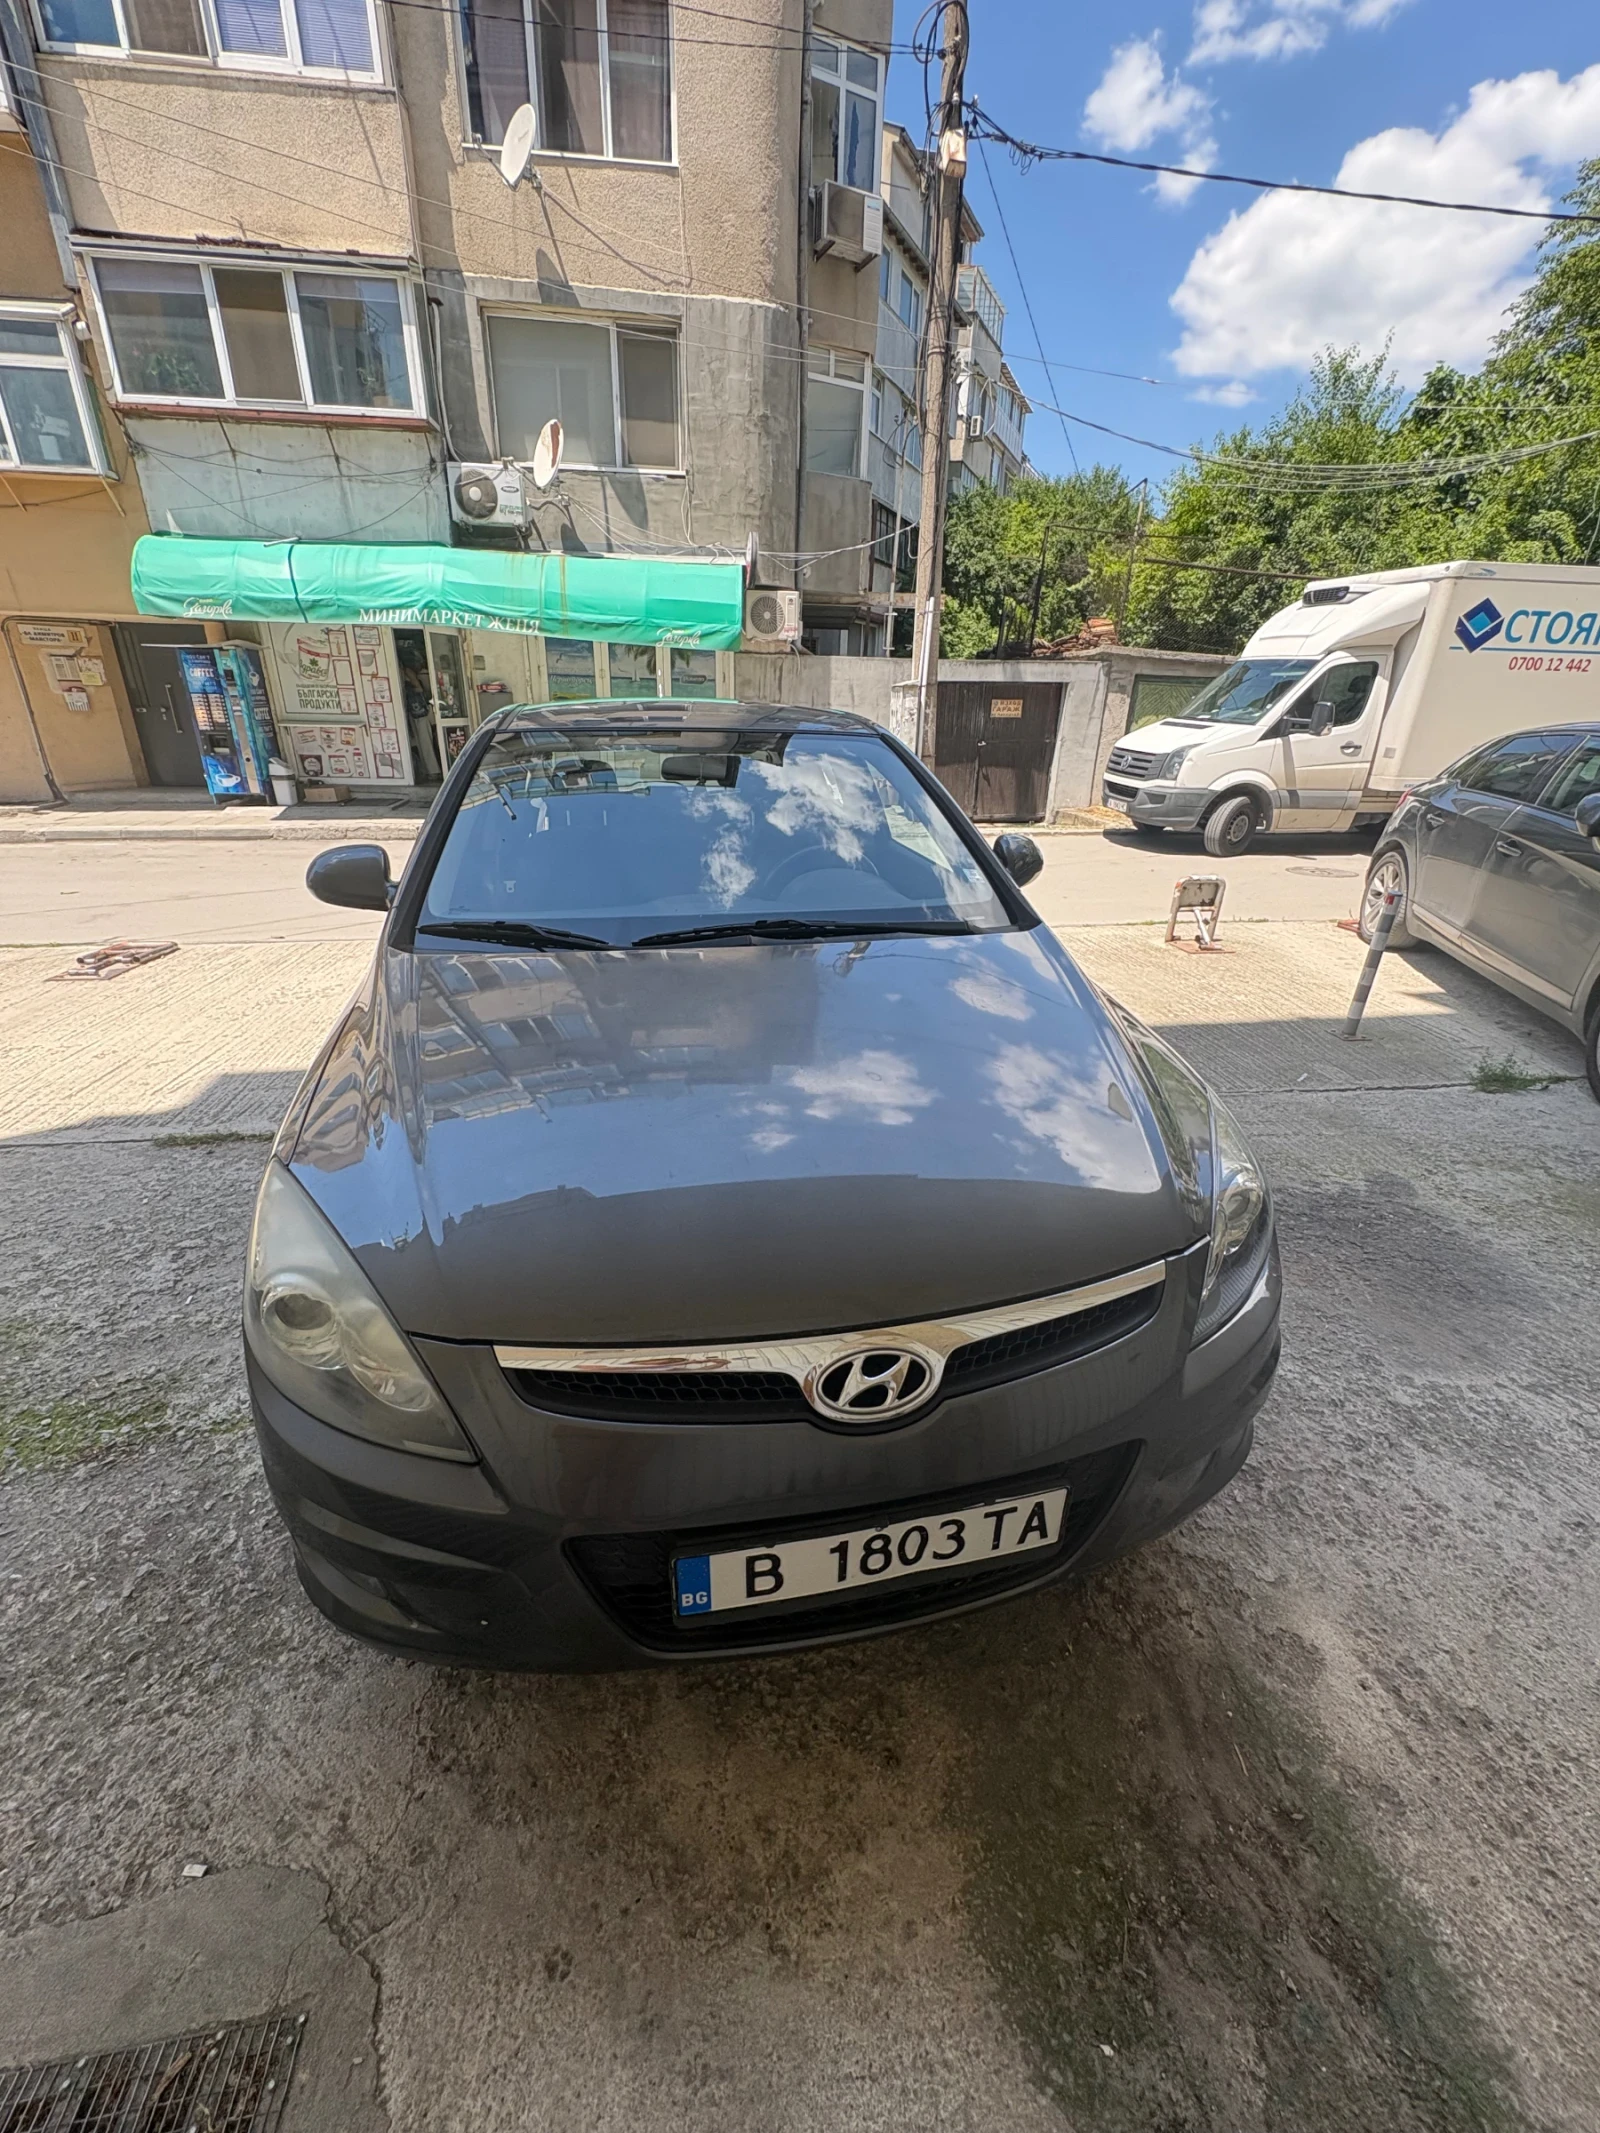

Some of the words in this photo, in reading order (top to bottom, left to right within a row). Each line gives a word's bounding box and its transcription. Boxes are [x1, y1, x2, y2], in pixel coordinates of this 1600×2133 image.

[359, 608, 484, 627] МИНИМАРКЕТ
[487, 615, 540, 633] ЖЕНЯ
[1505, 609, 1600, 646] СТОЯ
[1508, 656, 1543, 671] 0700
[1545, 658, 1563, 671] 12
[1565, 658, 1591, 672] 442
[189, 667, 215, 678] COFFEE
[297, 689, 338, 699] БЪЛГАРСКИ
[299, 698, 340, 710] ПРОДУКТИ
[746, 1553, 784, 1598] B
[830, 1518, 966, 1582] 1803
[984, 1500, 1048, 1551] TA
[681, 1591, 708, 1608] BG
